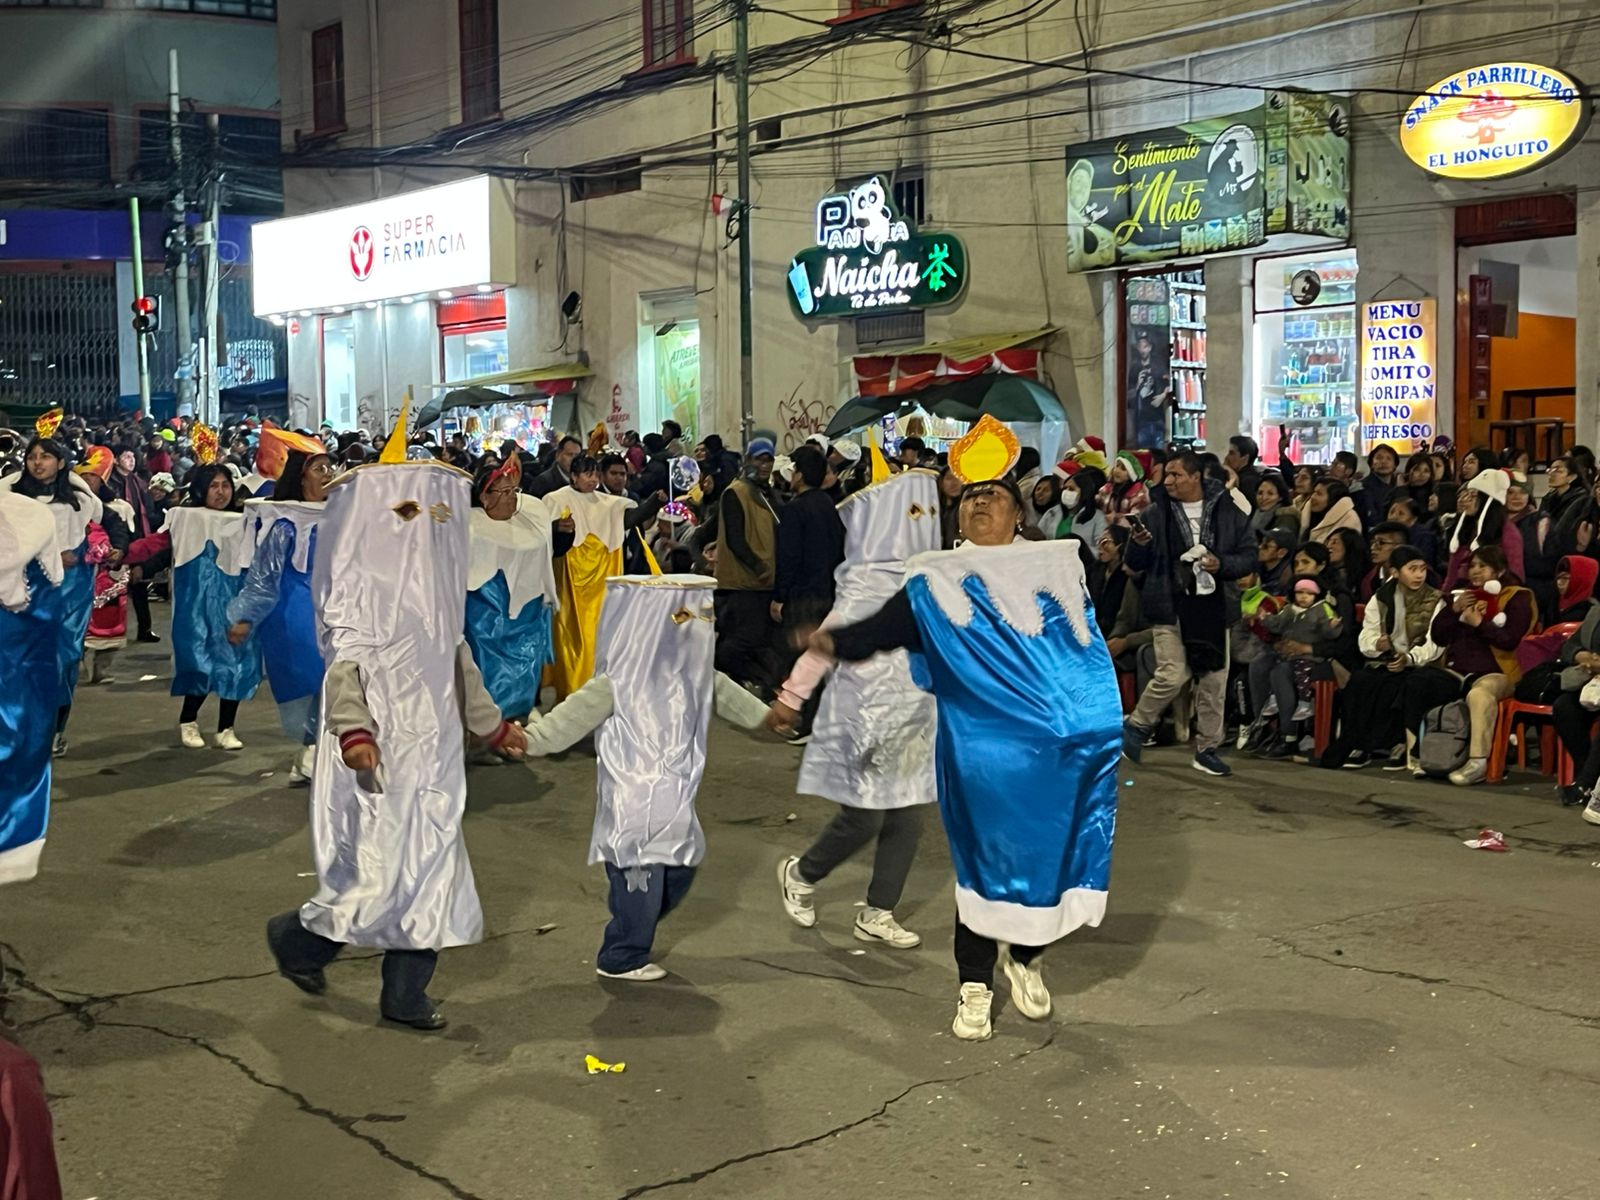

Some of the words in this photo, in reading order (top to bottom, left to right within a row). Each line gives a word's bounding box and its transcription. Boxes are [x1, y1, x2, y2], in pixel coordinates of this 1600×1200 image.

[1406, 78, 1462, 128] SNACK
[1467, 67, 1574, 104] PARRILLERO
[1113, 137, 1200, 176] Sentimiento
[1429, 154, 1448, 168] EL
[1454, 139, 1549, 165] HONGUITO
[1113, 169, 1205, 245] Mate
[383, 214, 434, 242] SUPER
[383, 232, 466, 264] FARMACIA
[814, 249, 921, 298] Naicha
[1368, 303, 1421, 320] MENU
[1367, 325, 1423, 341] VACIO
[1372, 345, 1416, 360] TIRA
[1364, 365, 1431, 381] LOMITO
[1374, 405, 1410, 419] VINO
[1362, 424, 1432, 439] REFRESCO
